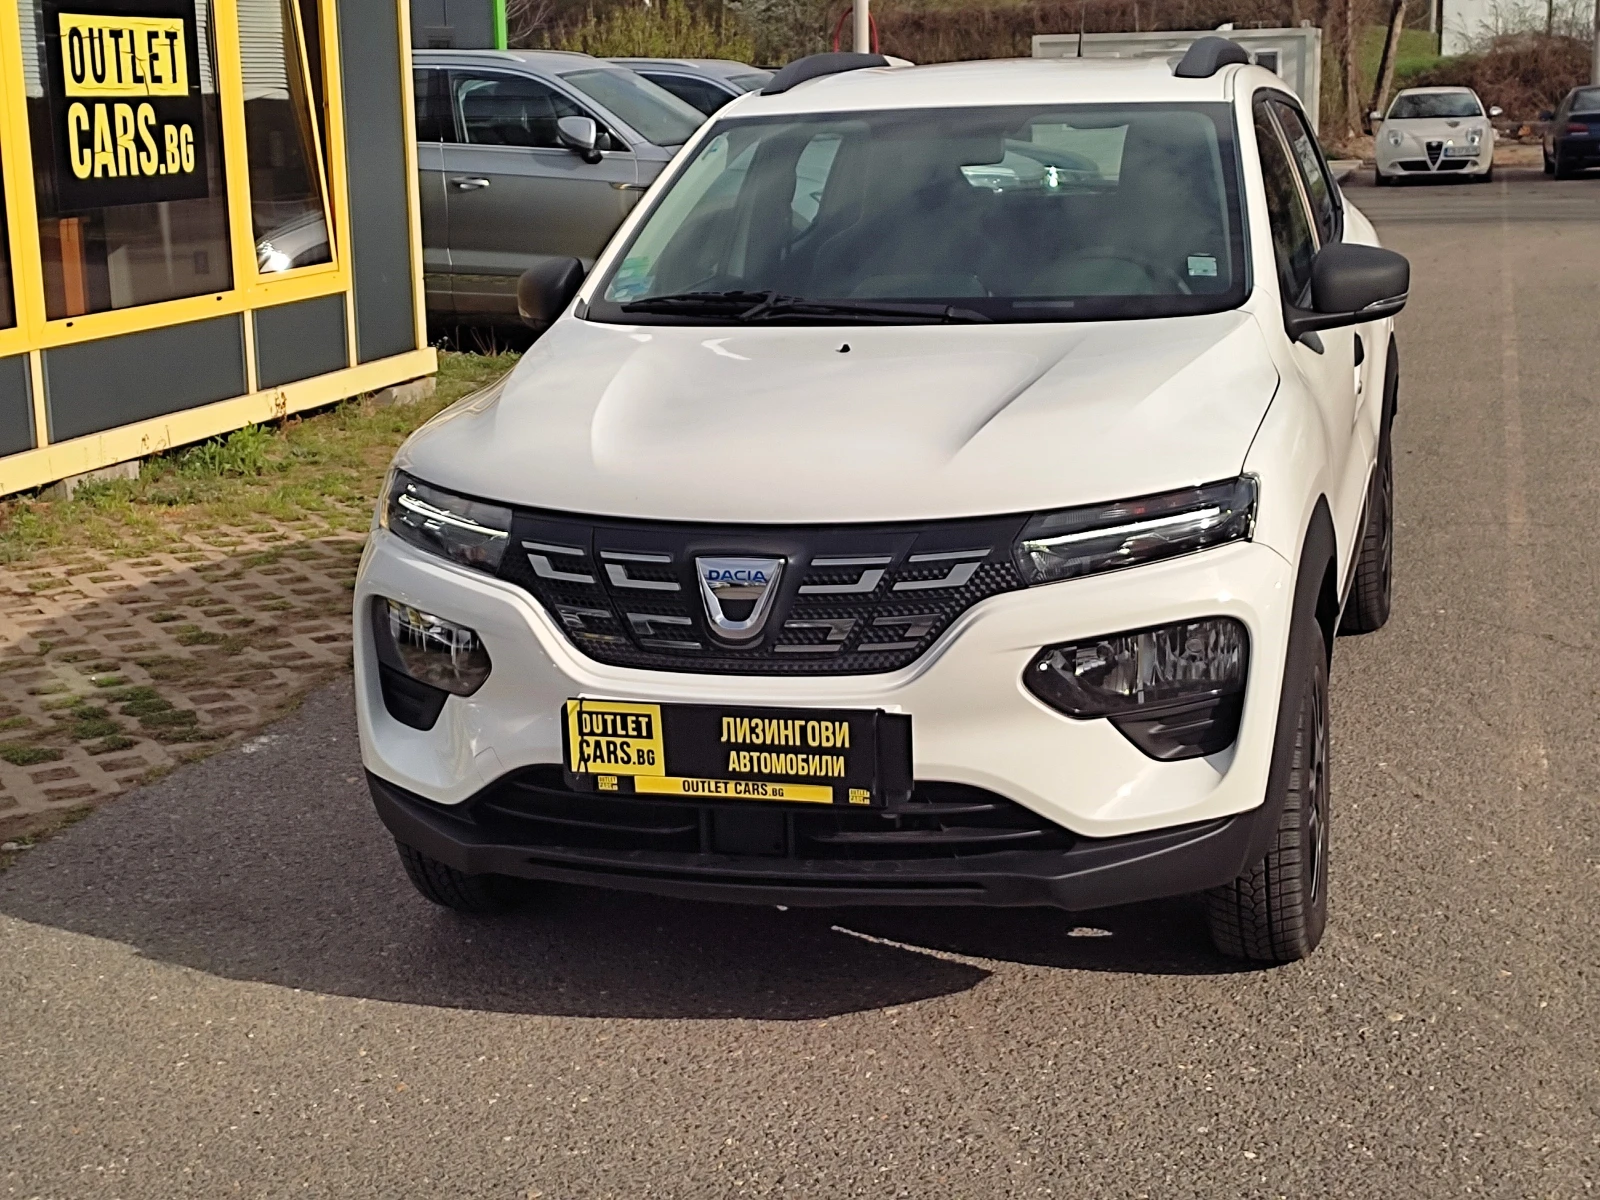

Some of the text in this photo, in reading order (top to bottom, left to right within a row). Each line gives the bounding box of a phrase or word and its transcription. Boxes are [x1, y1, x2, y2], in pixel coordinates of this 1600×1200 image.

[69, 26, 178, 84] OUTLET
[67, 102, 195, 179] CARS.BG
[708, 569, 768, 582] DACIA
[581, 713, 649, 737] OUTLET
[720, 716, 850, 748] ЛИЗИНГОВИ
[579, 739, 656, 766] CARS.BG
[728, 750, 845, 777] АВТОМОБИЛИ
[682, 779, 784, 797] OUTLET CARS.BG
